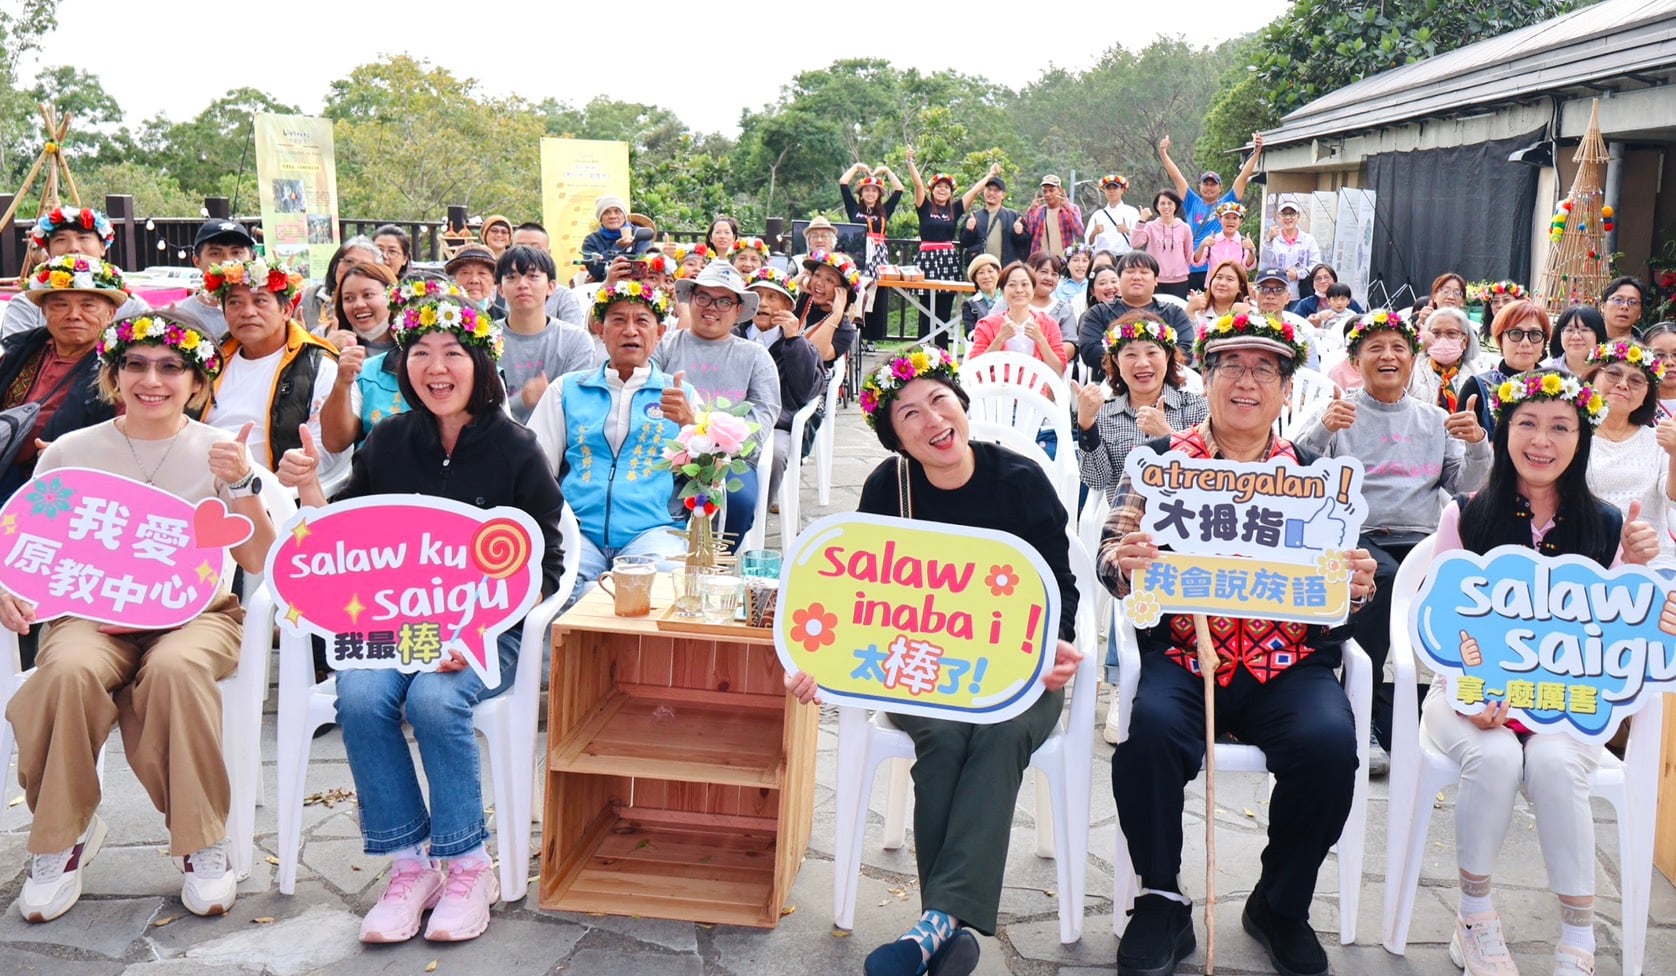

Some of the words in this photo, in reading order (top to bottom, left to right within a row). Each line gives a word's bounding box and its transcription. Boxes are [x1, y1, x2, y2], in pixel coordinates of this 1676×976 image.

[68, 496, 190, 567] 我愛
[1153, 499, 1284, 548] 大拇指
[4, 532, 198, 613] 原教中心
[289, 540, 407, 578] salaw
[419, 532, 467, 569] ku
[817, 540, 976, 593] salaw
[372, 577, 509, 630] saigu
[1144, 562, 1327, 607] 我會說族語
[1455, 563, 1656, 626] salaw
[852, 591, 973, 640] inaba
[334, 622, 440, 666] 我最棒
[850, 634, 989, 696] 太棒了!
[1456, 676, 1598, 715] 拿~麼厲害
